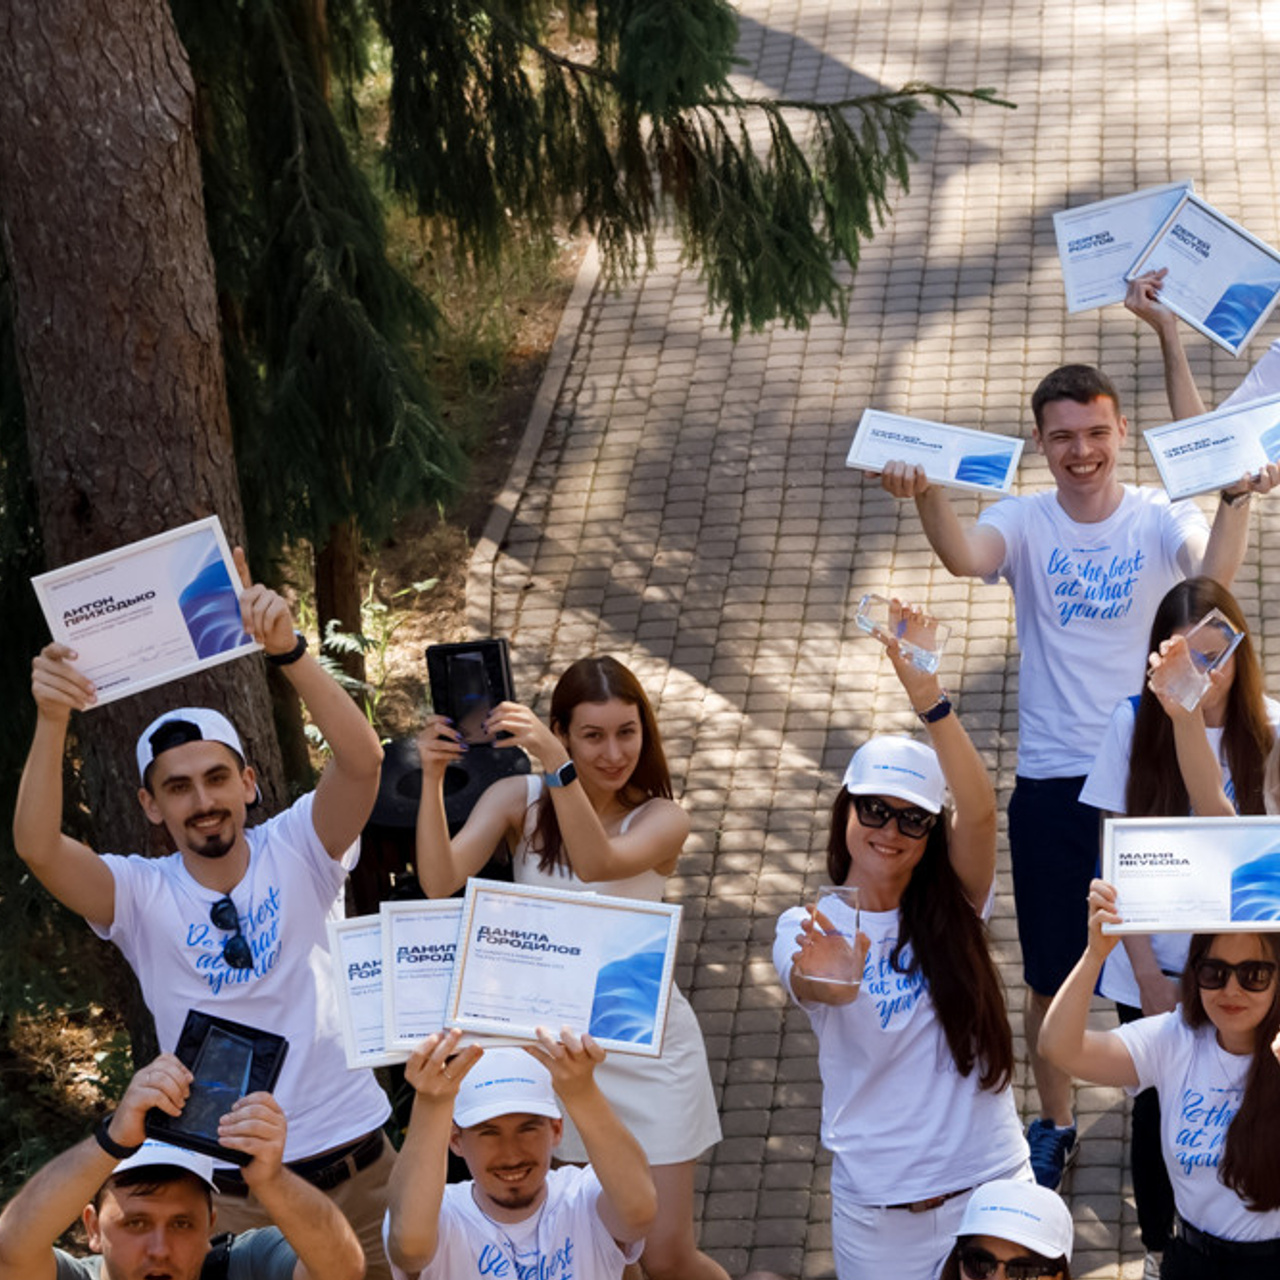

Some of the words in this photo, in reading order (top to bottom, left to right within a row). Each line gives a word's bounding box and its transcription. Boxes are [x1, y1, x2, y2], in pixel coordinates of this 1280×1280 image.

[1054, 579, 1082, 597] at
[63, 595, 114, 620] АНТОН
[64, 590, 157, 628] ПРИХОДЬКО
[478, 925, 549, 943] ДАНИЛА
[397, 943, 457, 957] ДАНИЛ
[476, 934, 582, 956] ГОРОДИЛОВ
